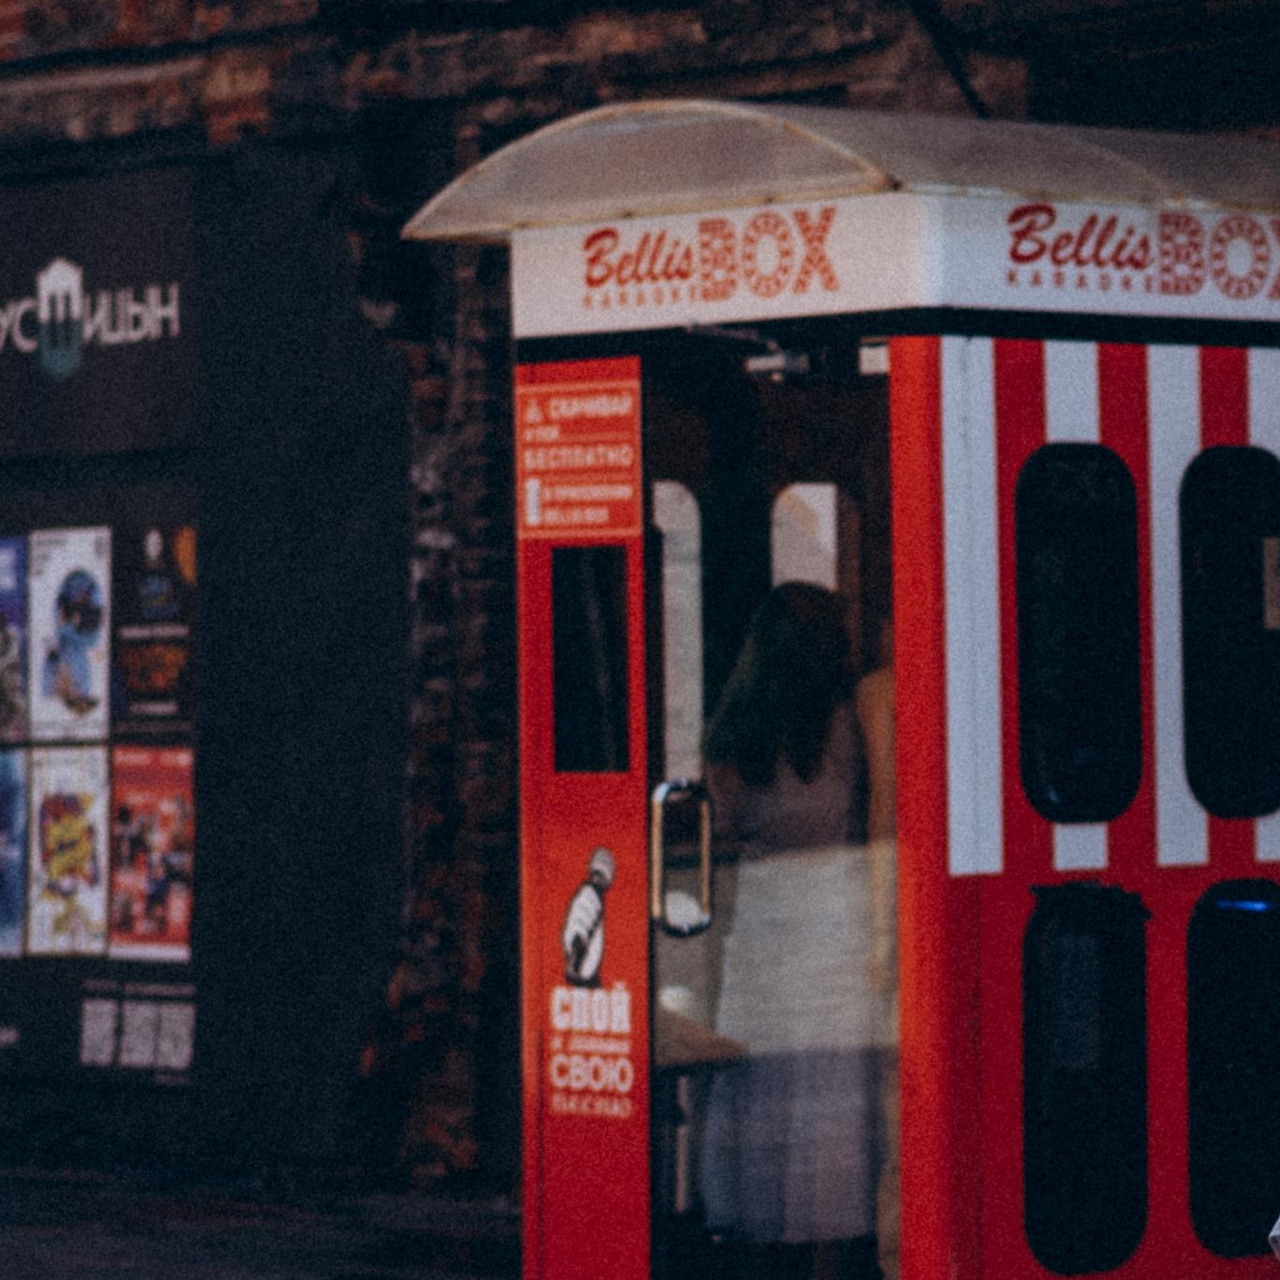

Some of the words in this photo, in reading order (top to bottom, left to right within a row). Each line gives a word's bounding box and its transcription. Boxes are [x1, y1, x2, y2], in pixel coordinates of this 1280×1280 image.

[583, 227, 694, 288] Bellis
[698, 205, 840, 303] BOX
[1006, 203, 1153, 271] Bellis
[551, 981, 632, 1034] СПОЙ
[549, 1053, 634, 1094] СВОЮ
